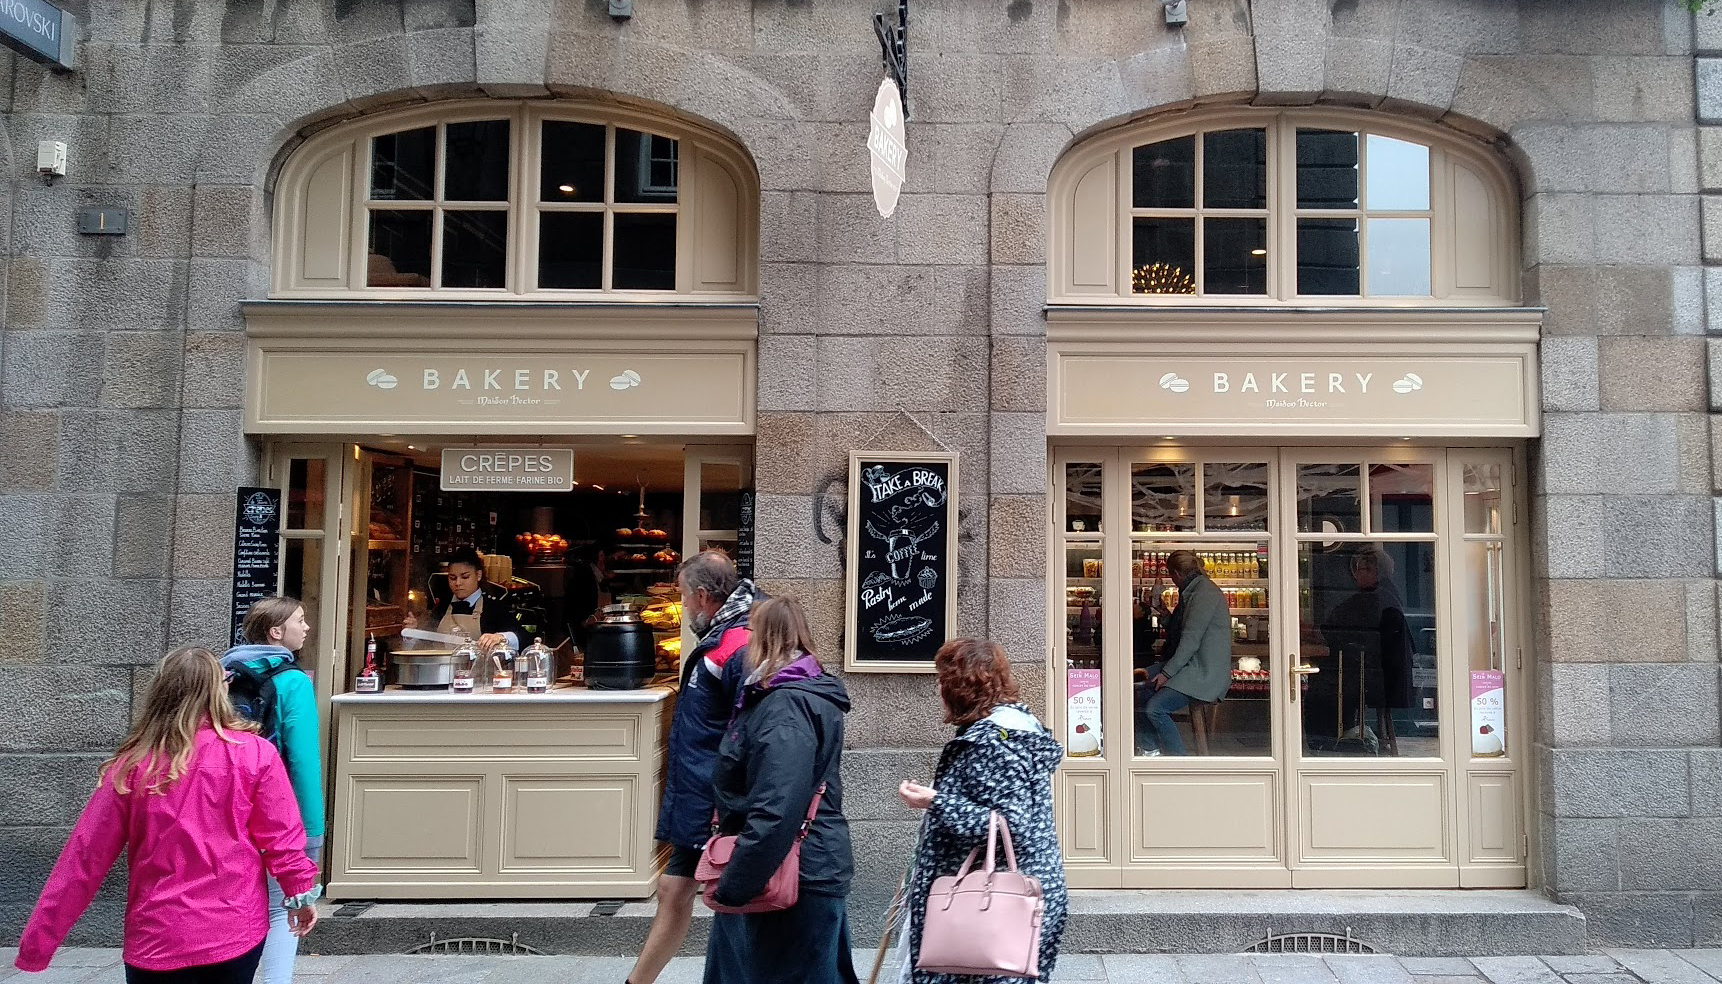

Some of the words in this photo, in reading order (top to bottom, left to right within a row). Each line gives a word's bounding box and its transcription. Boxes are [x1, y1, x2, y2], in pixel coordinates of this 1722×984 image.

[874, 124, 903, 171] BAKERY
[423, 369, 590, 390] BAKERY
[1213, 372, 1373, 393] BAKERY
[477, 395, 509, 405] Maison
[510, 394, 541, 405] Hector
[1265, 398, 1297, 409] Maison
[1297, 397, 1328, 408] Hector
[449, 475, 470, 484] LAIT
[472, 475, 484, 484] DE
[547, 476, 564, 485] BIO
[874, 475, 903, 499] TAKE
[913, 470, 944, 492] BREAK
[885, 544, 920, 563] COFFEE
[861, 586, 893, 610] Pastry
[888, 596, 907, 612] home
[909, 589, 933, 612] made
